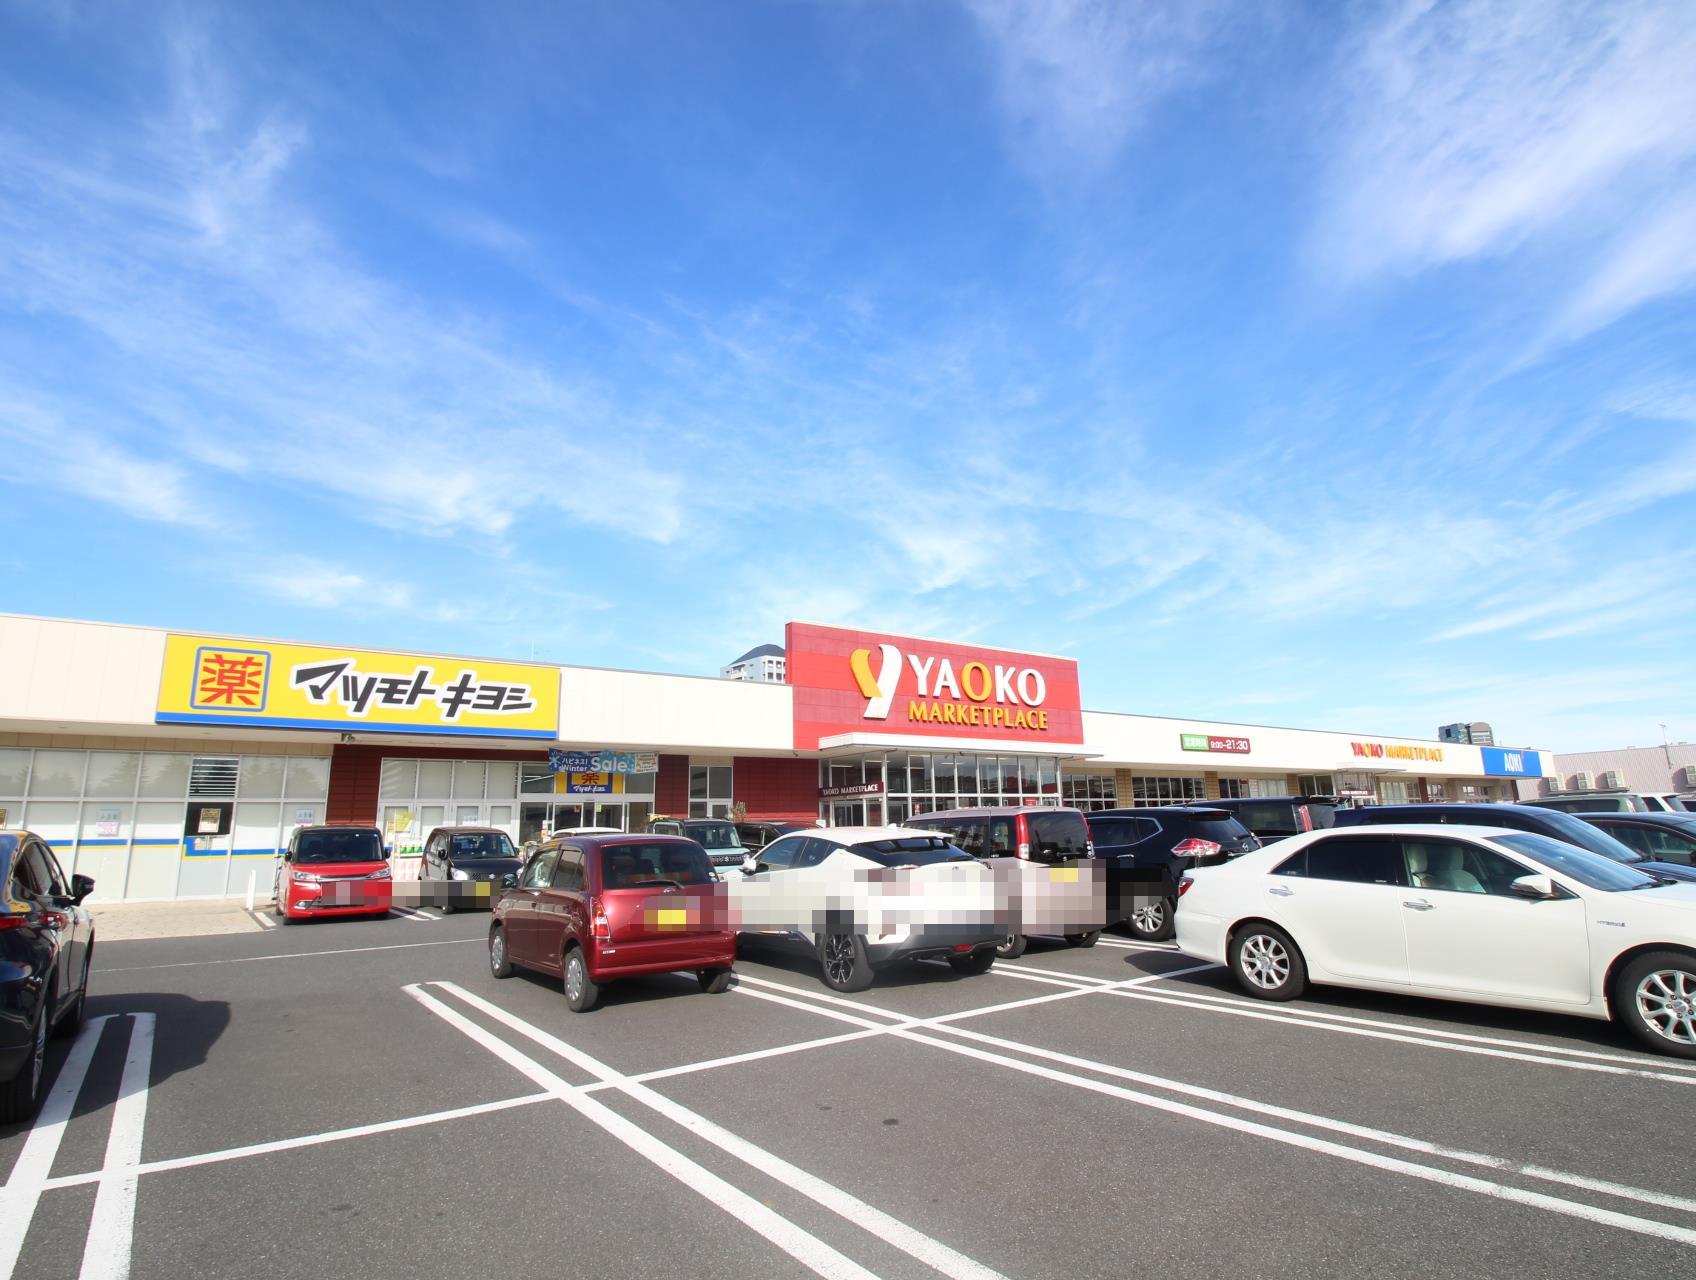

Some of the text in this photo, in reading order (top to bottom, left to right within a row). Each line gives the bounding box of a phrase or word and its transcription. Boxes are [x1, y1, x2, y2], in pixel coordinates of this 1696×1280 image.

[200, 653, 263, 706] 薬
[295, 662, 533, 718] マツモトキヨシ
[907, 654, 1046, 706] YAOKO
[908, 700, 1048, 729] MARKETPLACE
[1351, 742, 1443, 761] YAOKO MARKETPLACE
[1504, 752, 1523, 772] AOKI
[559, 764, 587, 772] Winter
[590, 756, 628, 772] Sale
[841, 784, 878, 794] MARKETPLACE
